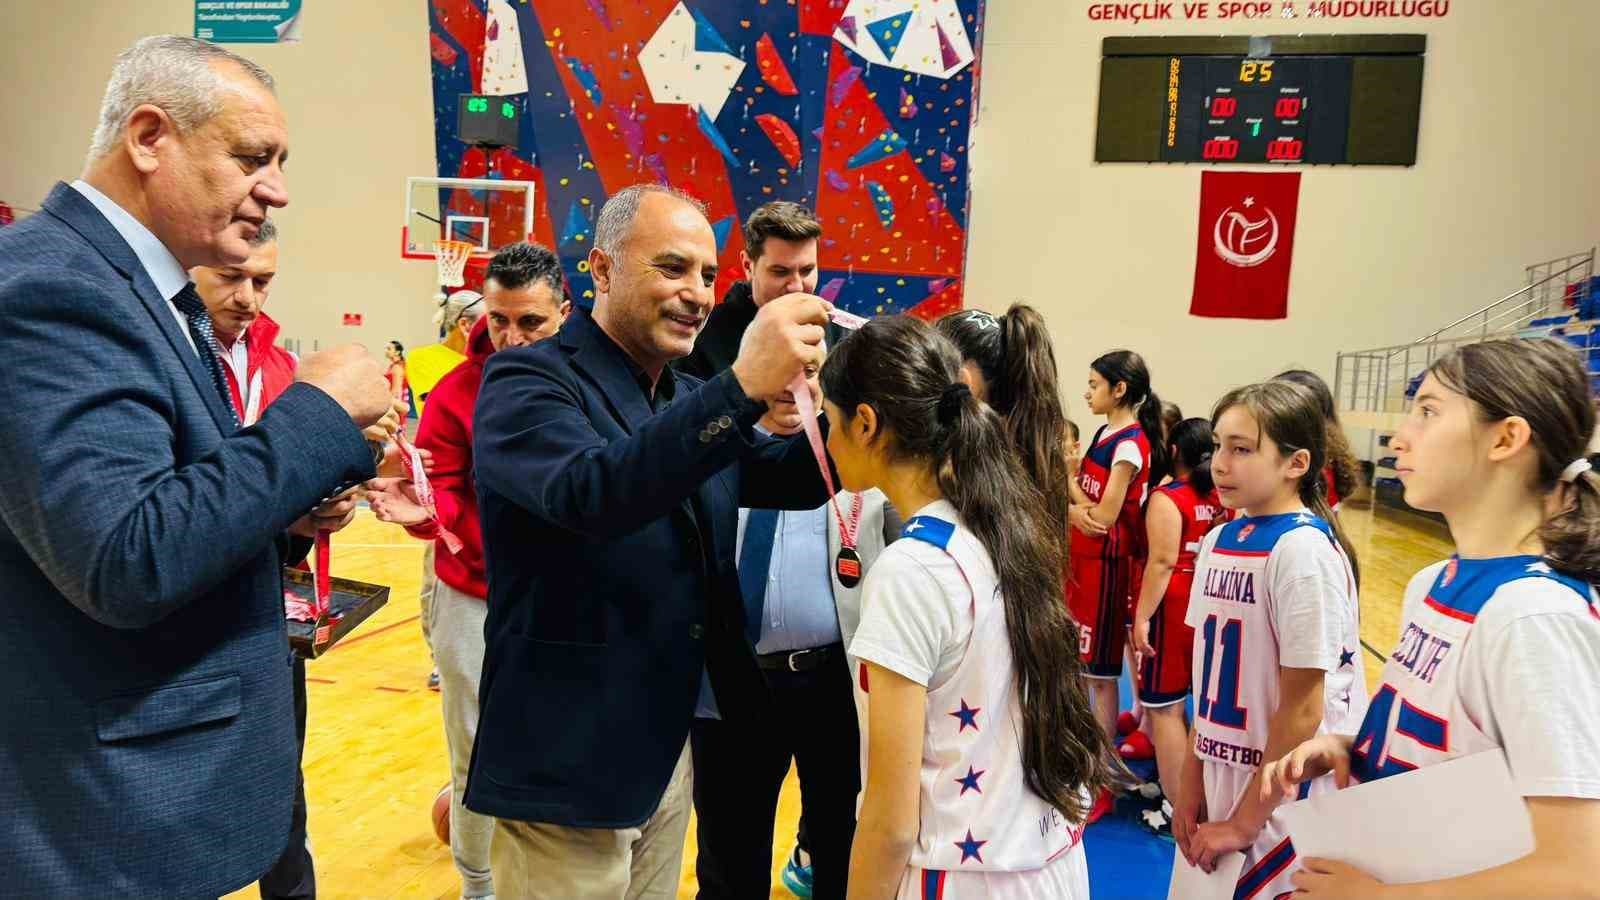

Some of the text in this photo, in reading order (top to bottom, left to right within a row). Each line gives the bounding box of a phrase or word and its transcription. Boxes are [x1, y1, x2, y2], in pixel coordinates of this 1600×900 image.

[1088, 0, 1173, 24] GENÇLİK
[1184, 2, 1209, 19] VE
[1203, 566, 1256, 604] ALMİNA
[1198, 613, 1249, 731] 11
